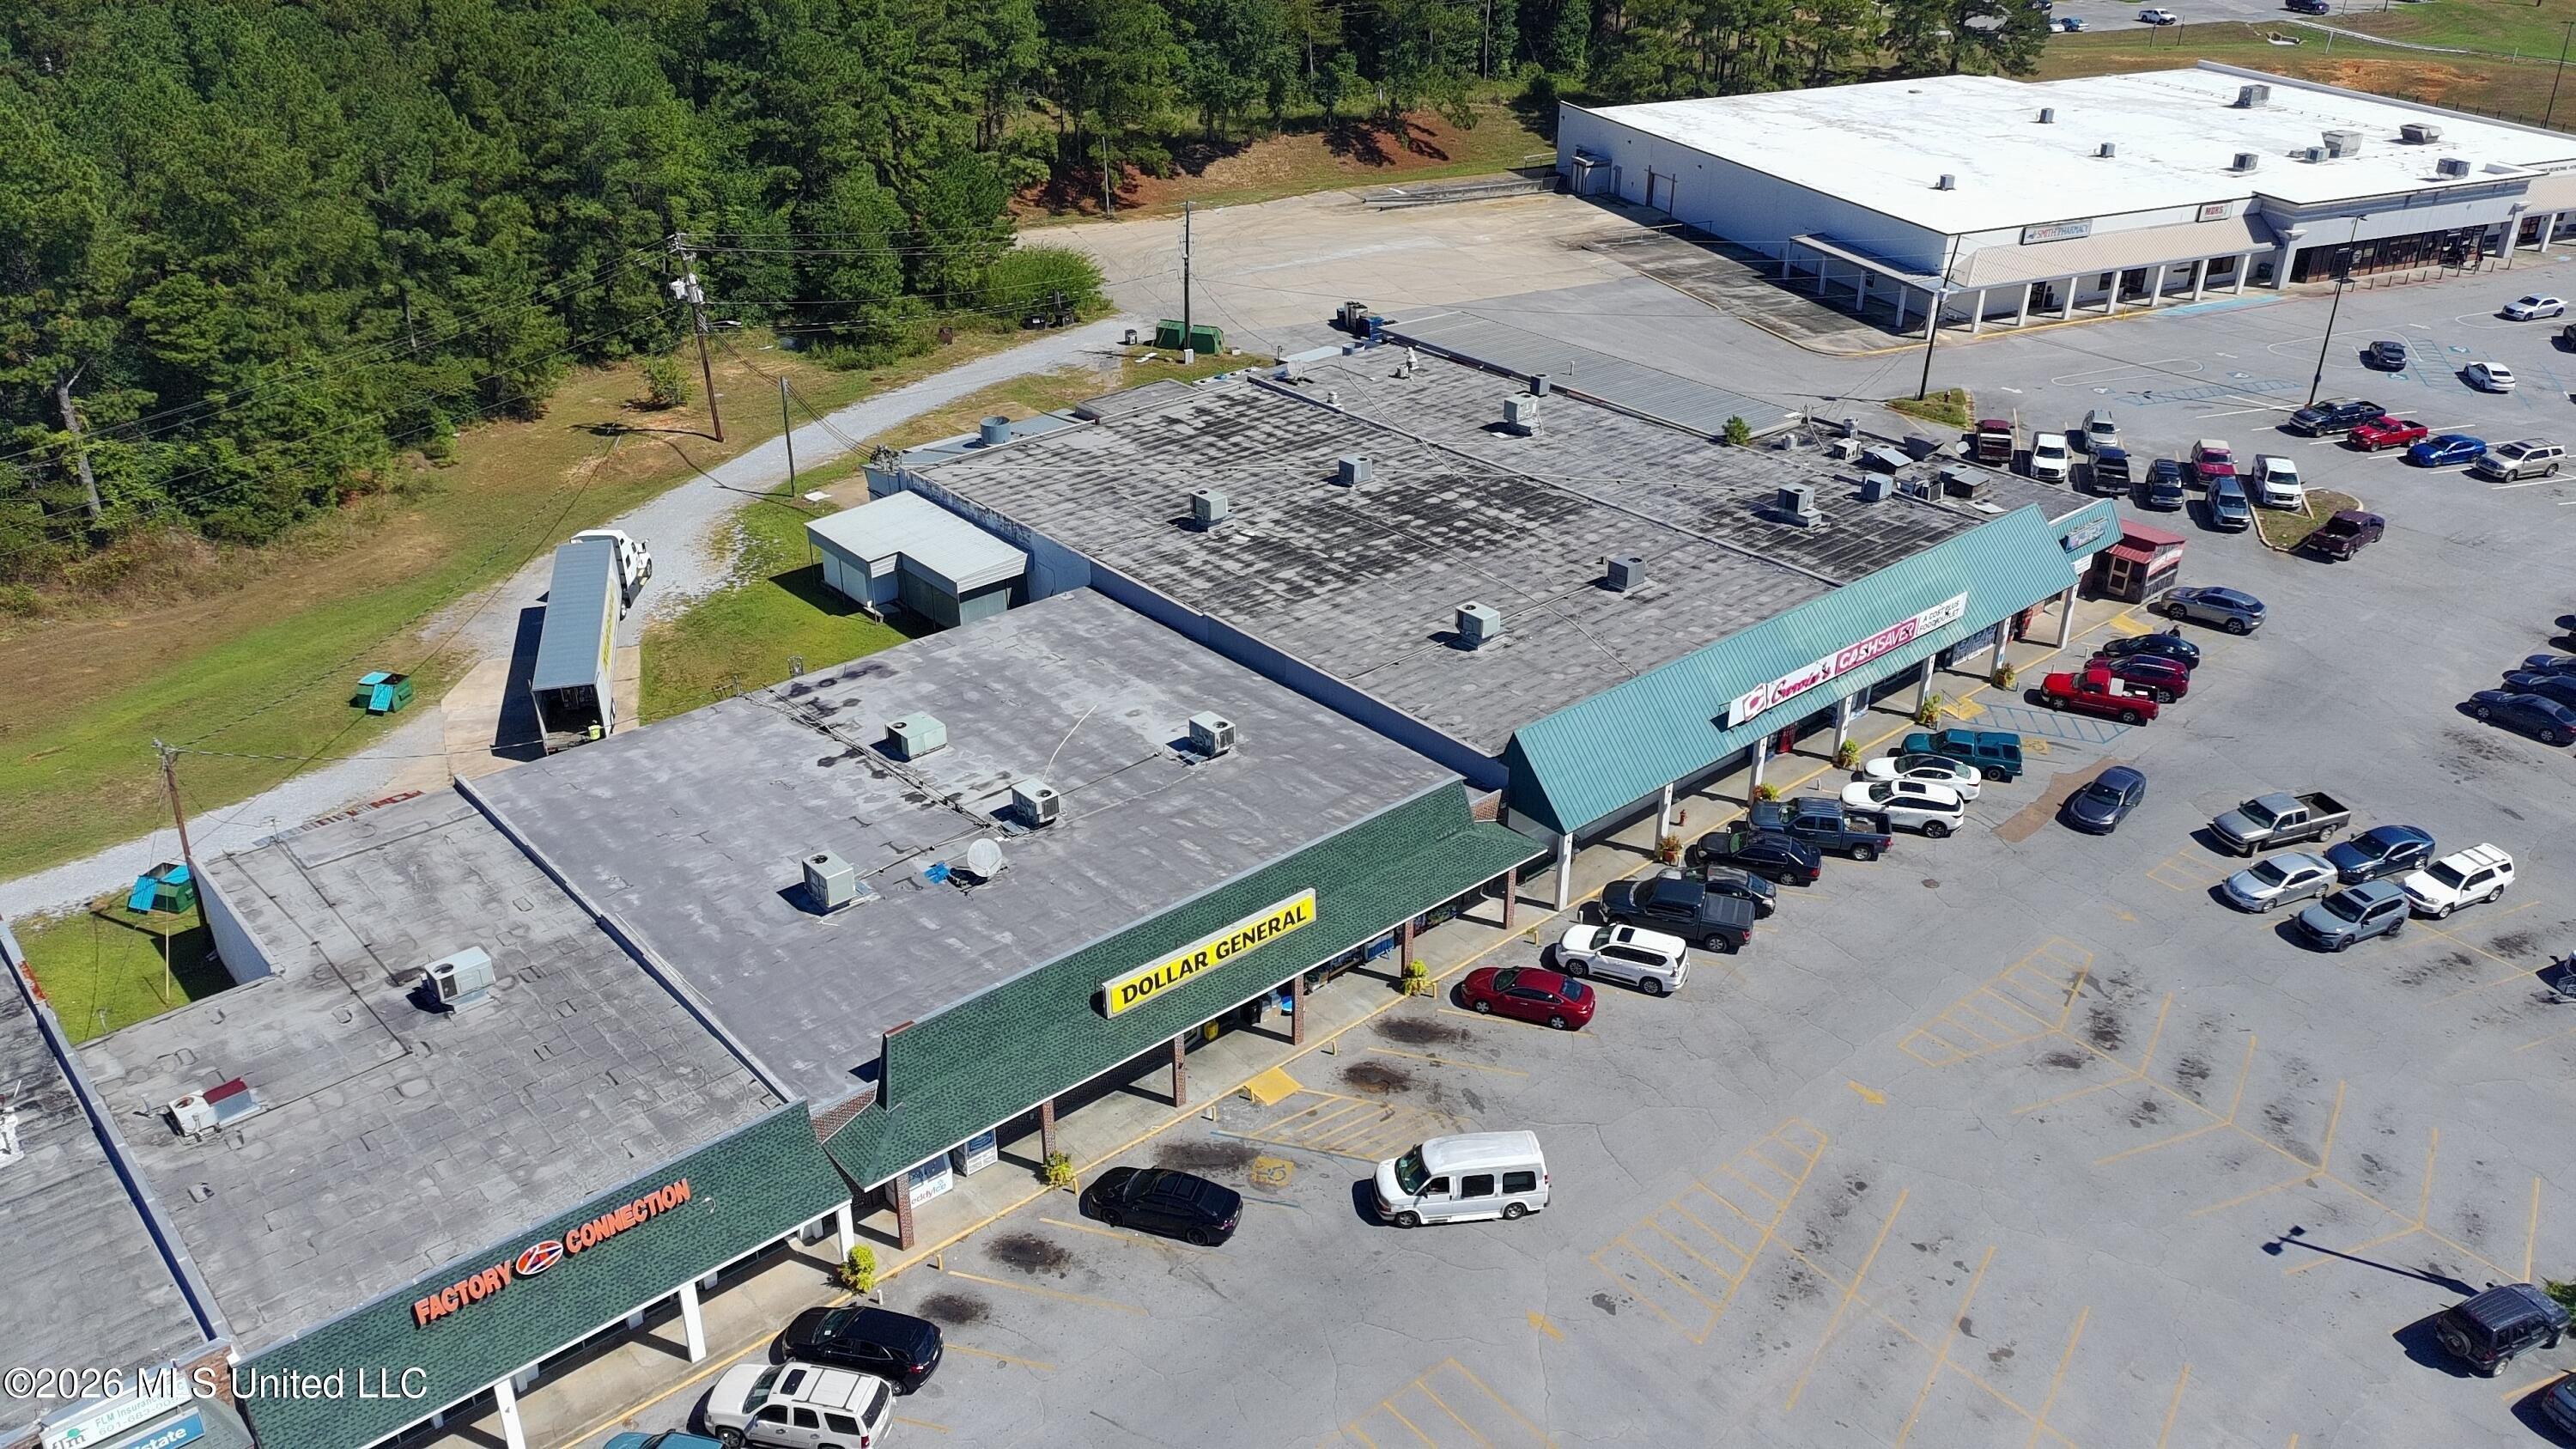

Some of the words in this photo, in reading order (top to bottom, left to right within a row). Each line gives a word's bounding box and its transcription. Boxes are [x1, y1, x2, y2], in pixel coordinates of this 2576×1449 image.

[1121, 951, 1209, 1004] DOLLAR
[1215, 904, 1307, 960] GENERAL
[414, 1259, 513, 1327] FACTORY
[566, 1178, 691, 1254] CONNECTION
[95, 1412, 115, 1428] FLM
[117, 1393, 162, 1418] Insurance
[133, 1428, 187, 1449] state
